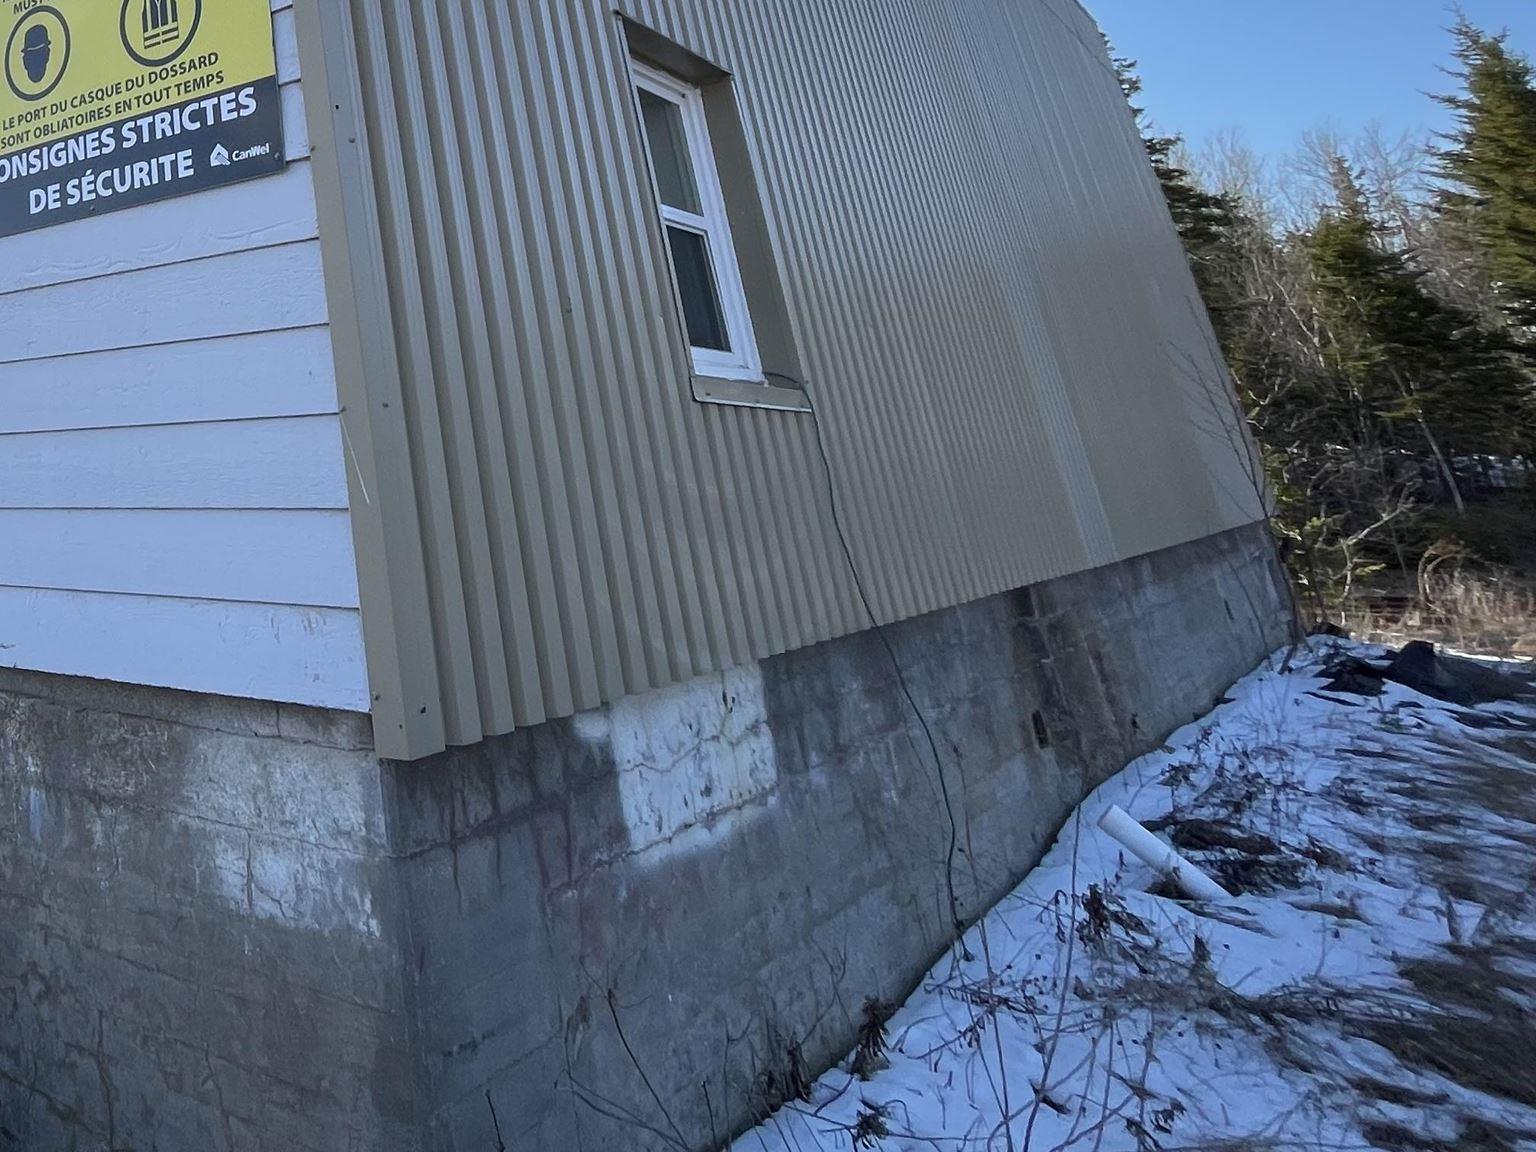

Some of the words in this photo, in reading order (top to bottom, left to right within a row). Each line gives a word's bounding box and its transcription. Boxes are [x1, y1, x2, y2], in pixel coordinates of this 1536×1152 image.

[0, 128, 32, 150] SONT
[33, 104, 112, 139] OBLIATOIRES
[115, 99, 133, 116] EN
[136, 85, 172, 109] TOUT
[174, 69, 225, 97] TEMPS
[2, 115, 16, 132] LE
[17, 106, 48, 127] PORT
[50, 99, 68, 116] DU
[70, 81, 123, 109] CASQUE
[125, 74, 145, 92] DU
[148, 51, 220, 85] DOSSARD
[121, 86, 258, 150] STRICTES
[28, 183, 62, 215] DE
[66, 148, 195, 206] SÉCURITE
[231, 142, 271, 162] CanWel
